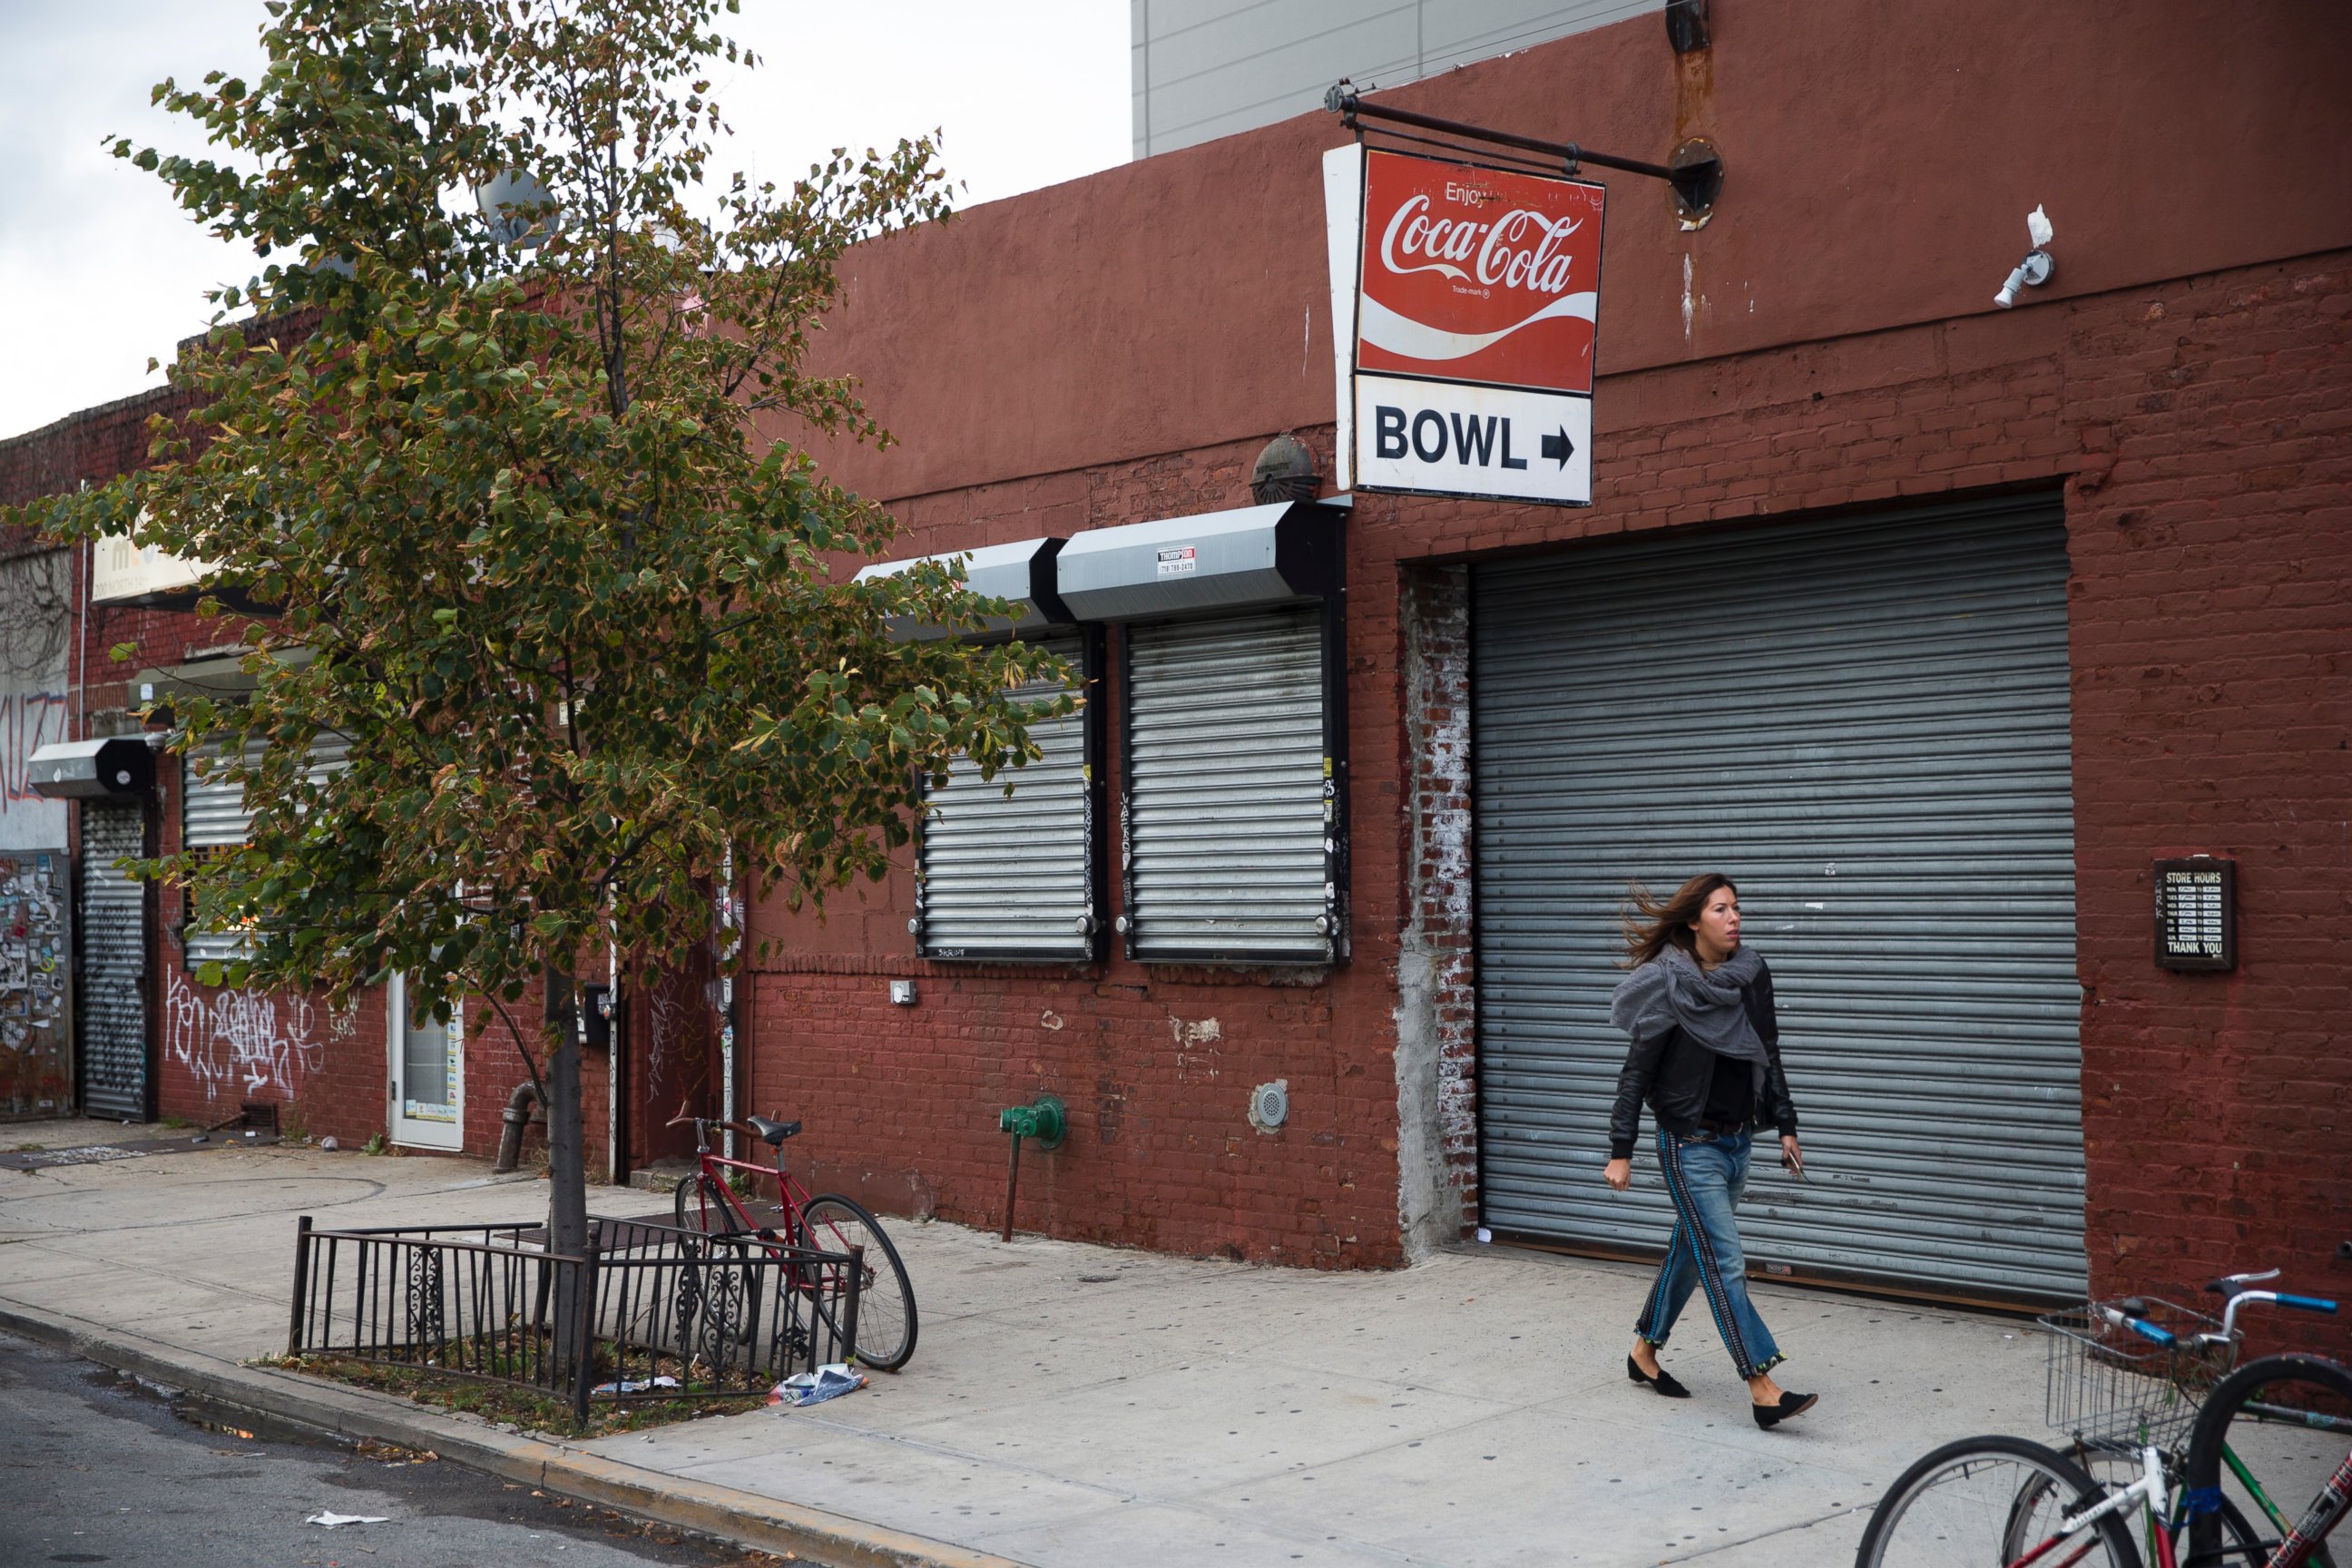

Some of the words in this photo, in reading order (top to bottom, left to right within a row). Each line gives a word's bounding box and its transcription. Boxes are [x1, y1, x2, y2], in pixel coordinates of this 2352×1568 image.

[1446, 181, 1487, 208] Enjoy
[1380, 194, 1583, 293] Coca-Cola
[1376, 406, 1527, 470] BOWL
[1160, 550, 1192, 561] THOMPSON
[108, 576, 133, 594] NORTH
[2166, 872, 2191, 884] STORE
[2194, 872, 2221, 884] HOURS
[2168, 942, 2200, 953] THANK
[2203, 942, 2222, 954] YOU
